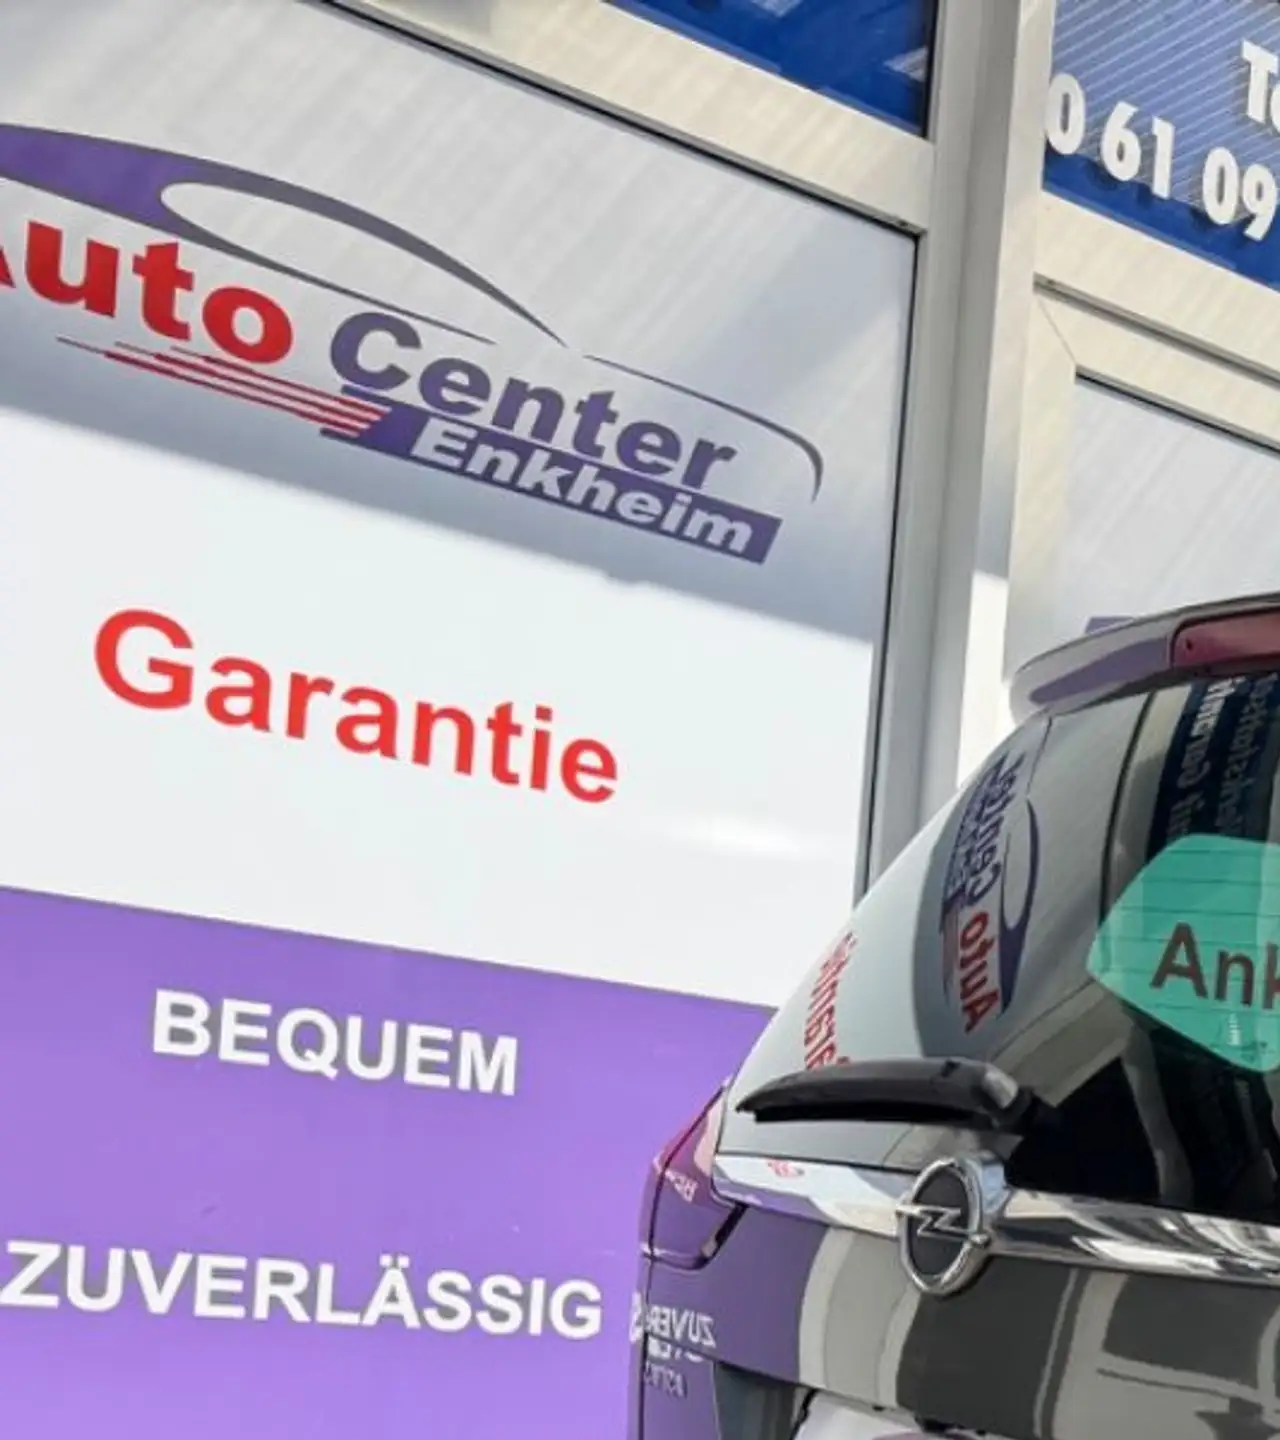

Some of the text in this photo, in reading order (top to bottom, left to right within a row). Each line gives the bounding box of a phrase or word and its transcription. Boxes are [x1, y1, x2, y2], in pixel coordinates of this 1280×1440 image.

[1045, 74, 1086, 155] 0
[1101, 102, 1176, 199] 61
[1202, 146, 1278, 241] 09
[0, 220, 737, 491] uto Center
[410, 416, 754, 554] Enkheim
[94, 608, 620, 803] Garantie
[152, 988, 518, 1096] BEQUEM
[1, 1240, 602, 1341] ZUVERLÄSSIG
